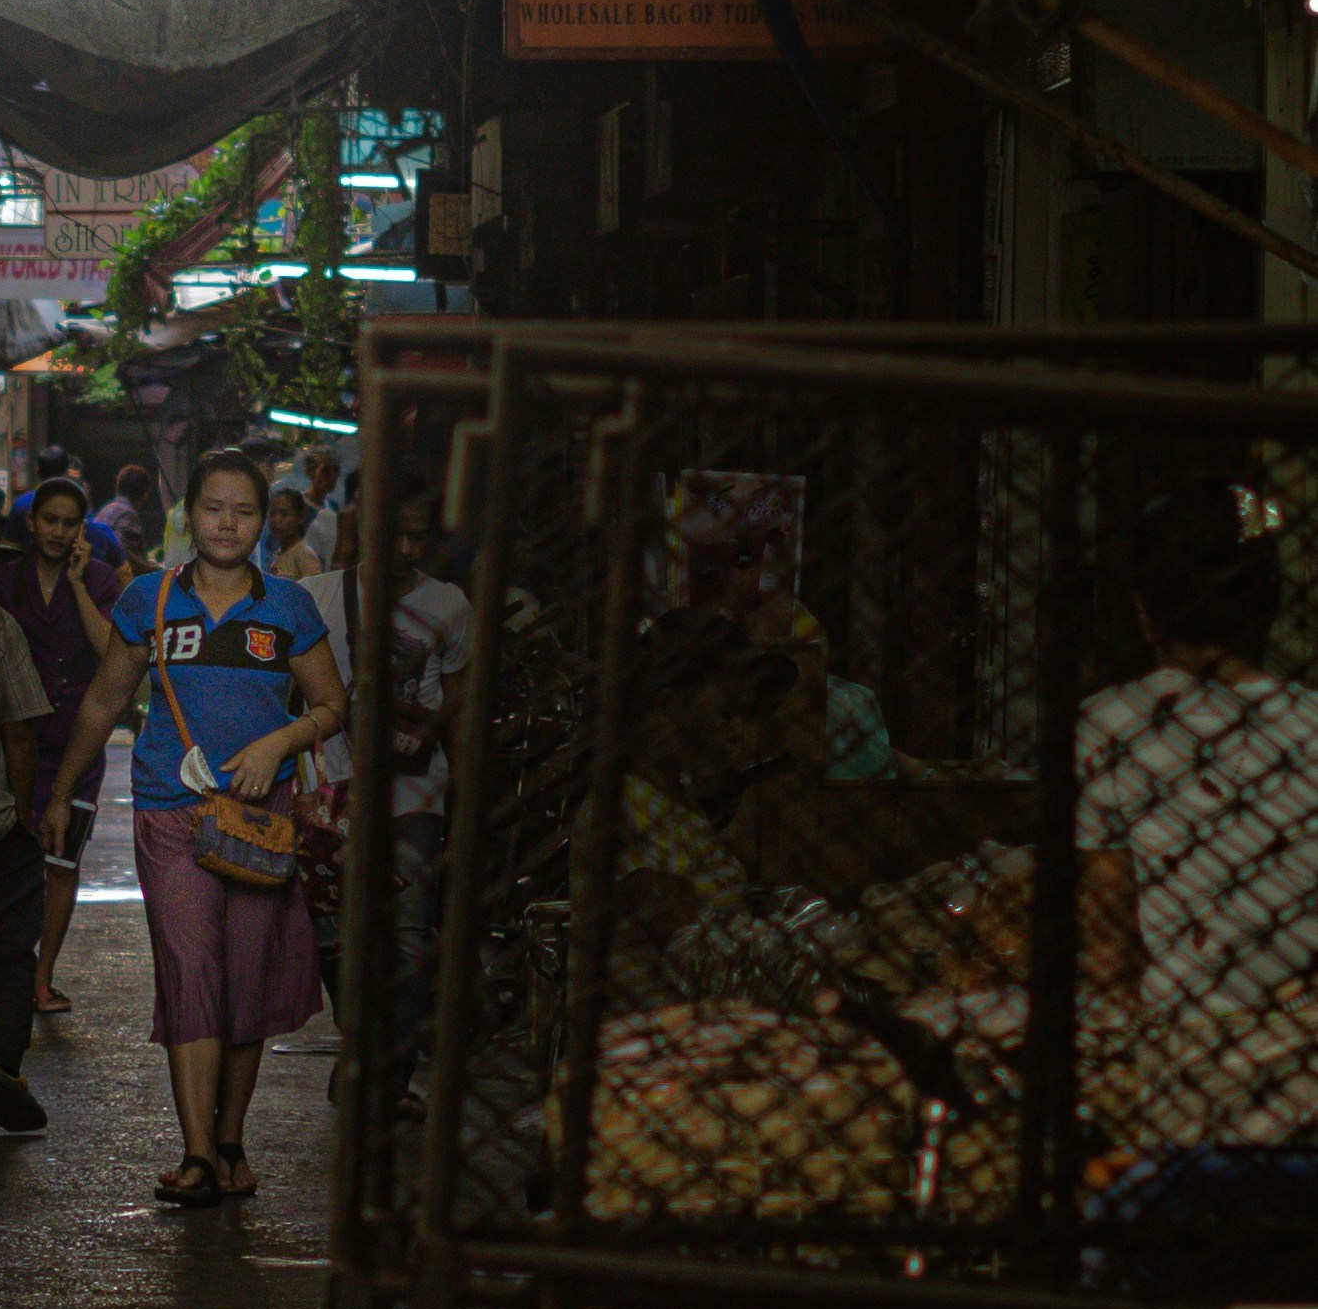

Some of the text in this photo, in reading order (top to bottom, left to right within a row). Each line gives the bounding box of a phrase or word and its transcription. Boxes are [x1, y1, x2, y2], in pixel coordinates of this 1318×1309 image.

[521, 2, 635, 25] WHOLESALE
[644, 2, 681, 25] BAG
[690, 2, 714, 25] OF
[55, 174, 81, 204] IN
